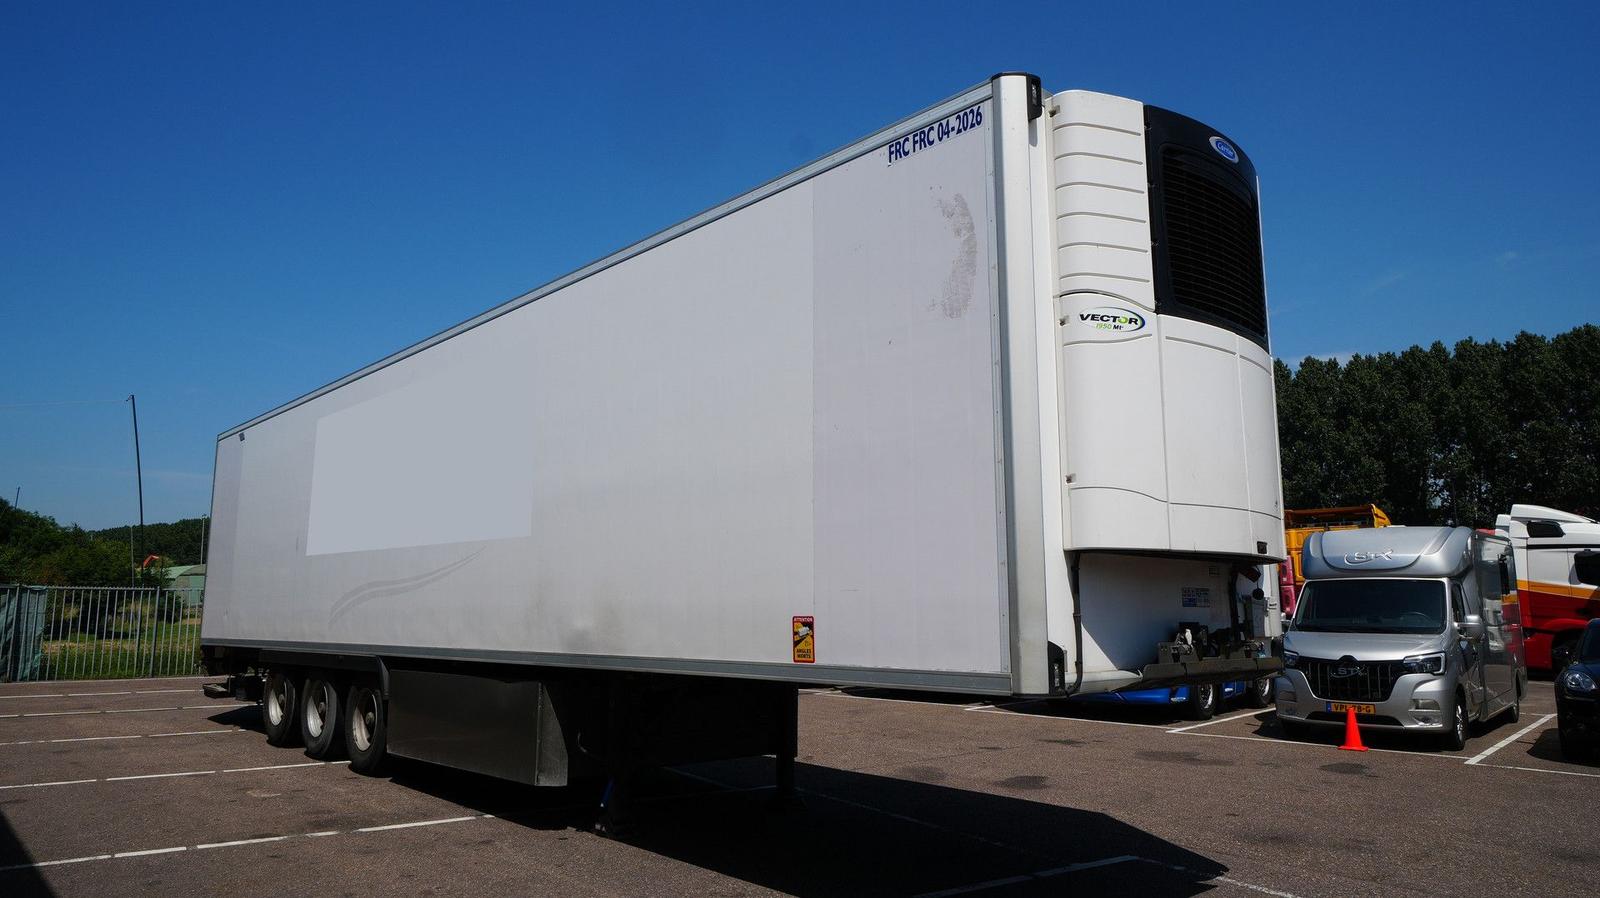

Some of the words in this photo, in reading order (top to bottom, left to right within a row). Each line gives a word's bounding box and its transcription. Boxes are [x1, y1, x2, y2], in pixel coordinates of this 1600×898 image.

[888, 136, 910, 163] FRC
[912, 125, 935, 153] FRC
[937, 105, 983, 142] 04-2026
[1079, 313, 1139, 325] VECTOR
